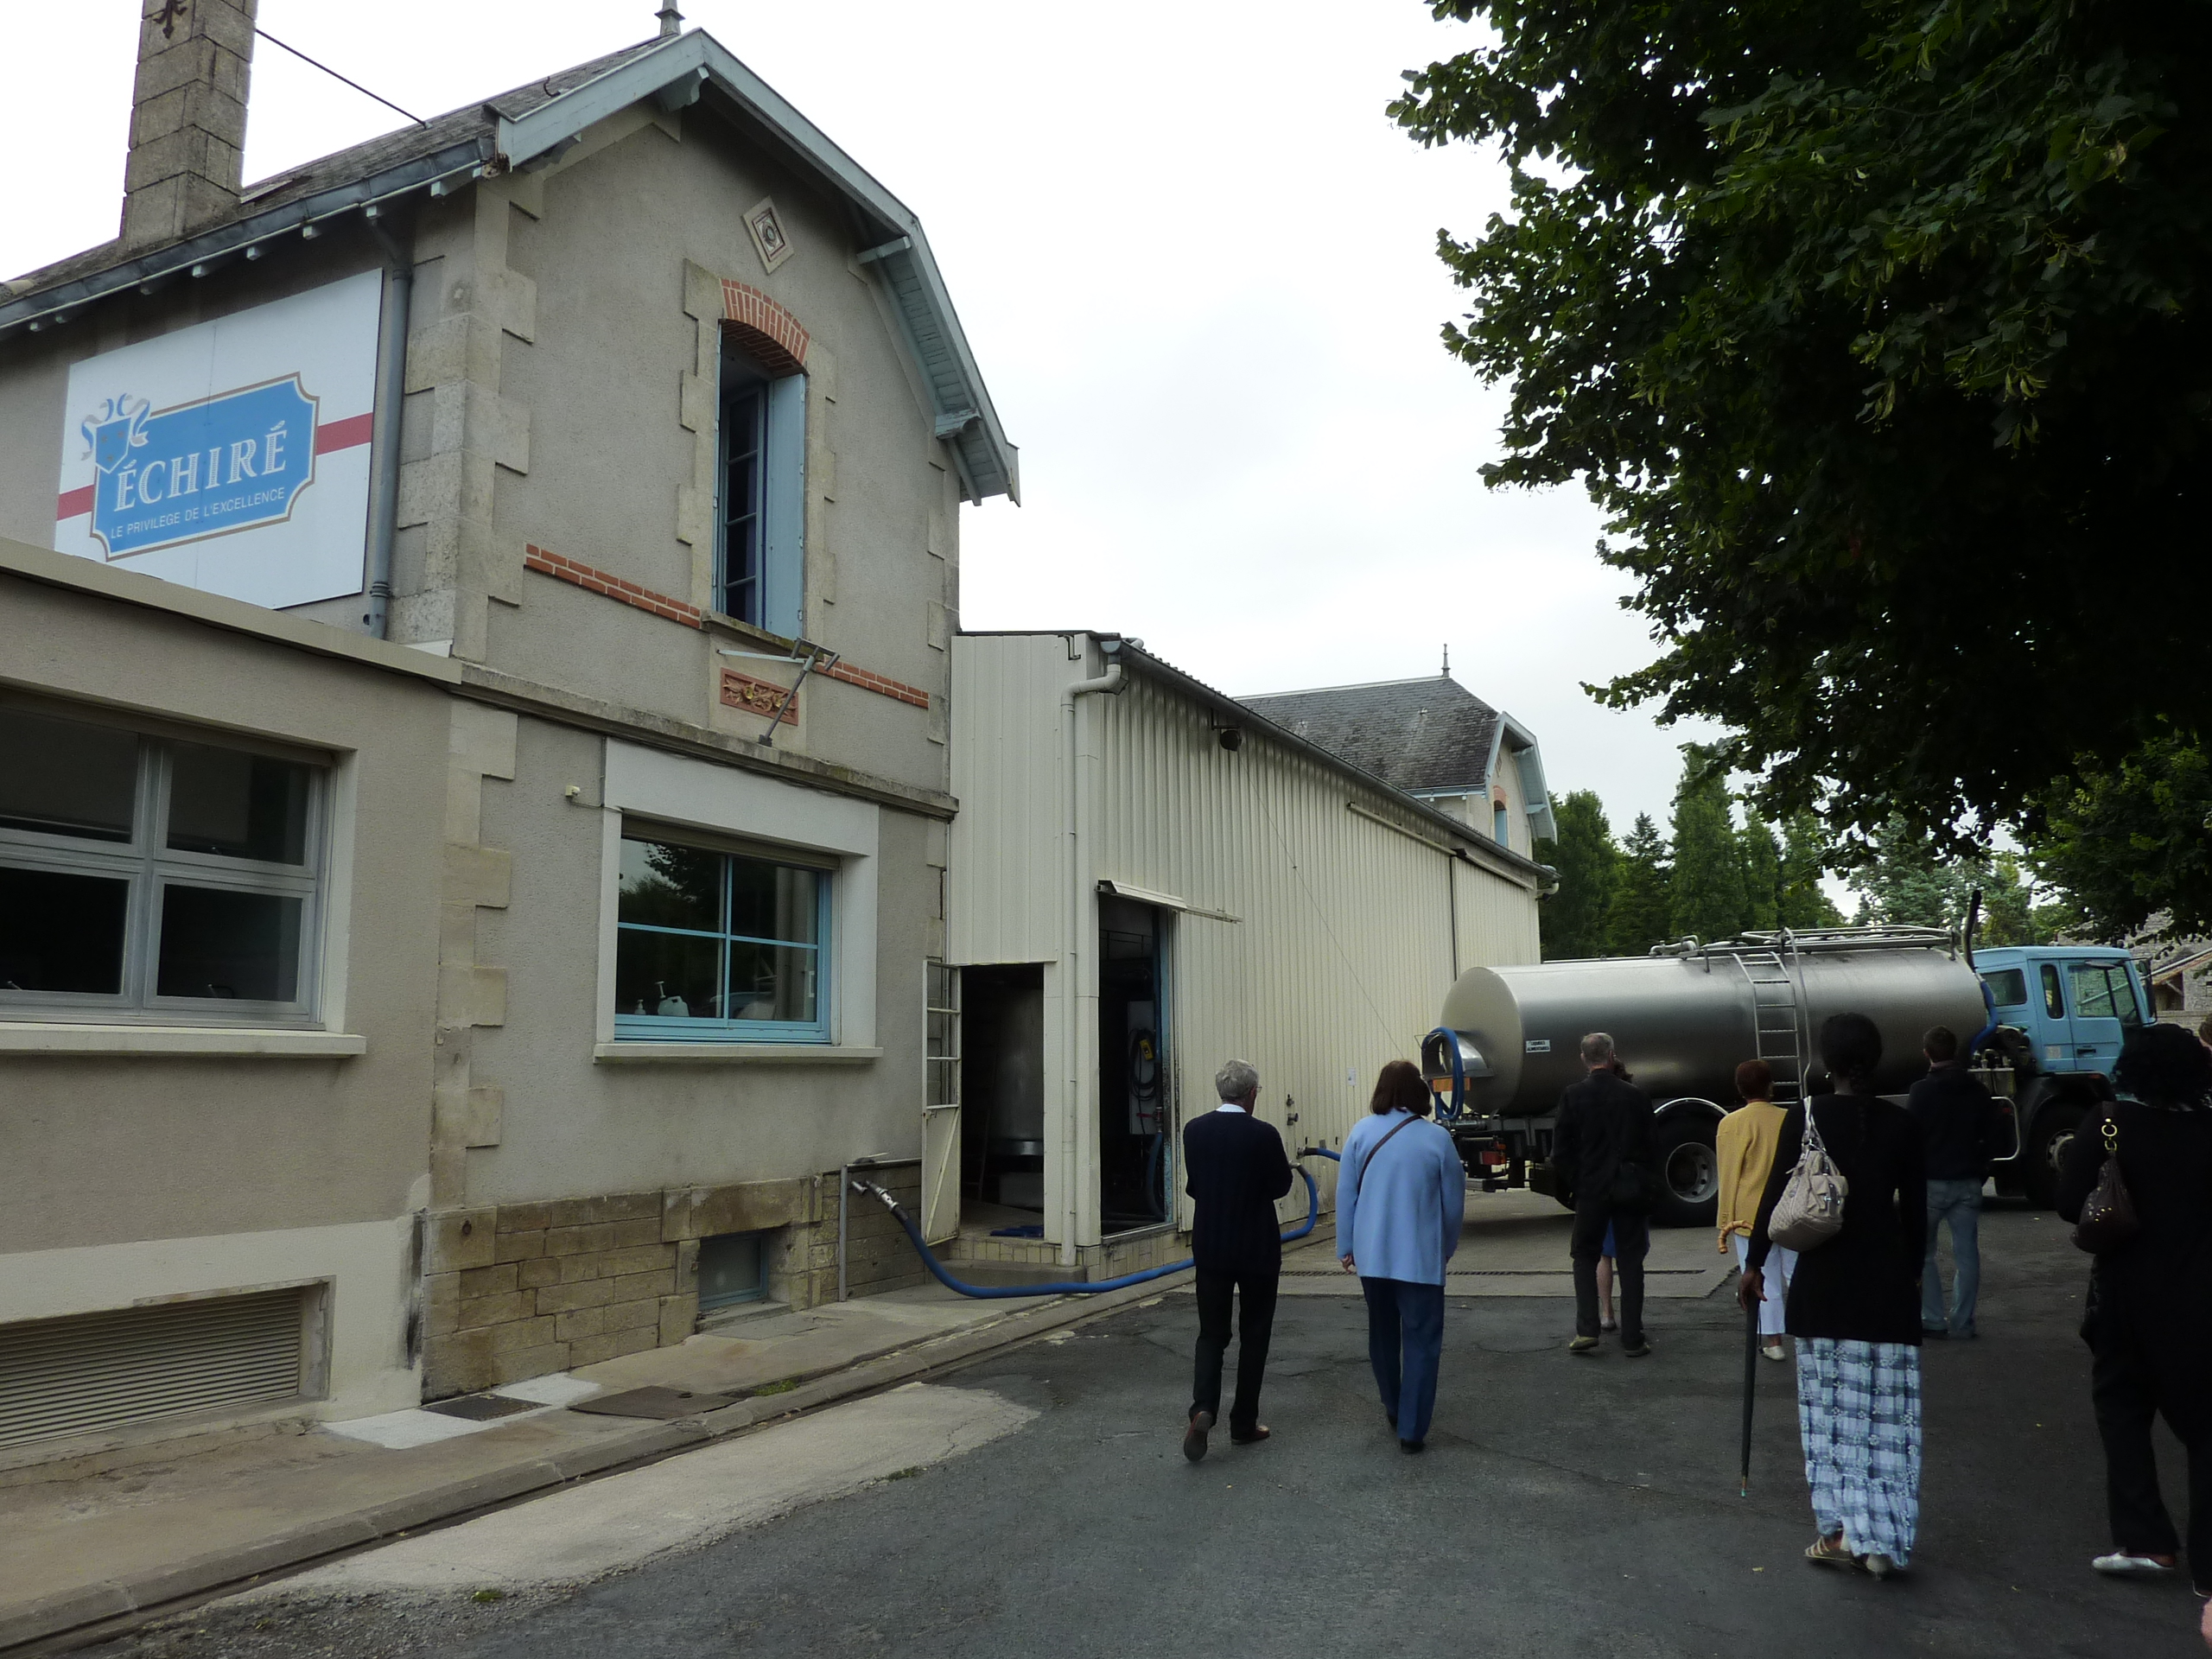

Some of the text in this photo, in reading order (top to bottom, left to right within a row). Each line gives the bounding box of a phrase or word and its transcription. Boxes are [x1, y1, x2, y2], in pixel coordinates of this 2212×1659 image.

[113, 420, 288, 512] ÉCHIRÉ
[111, 487, 285, 539] LE PRIVILEGE DE L'EXCELLENCE
